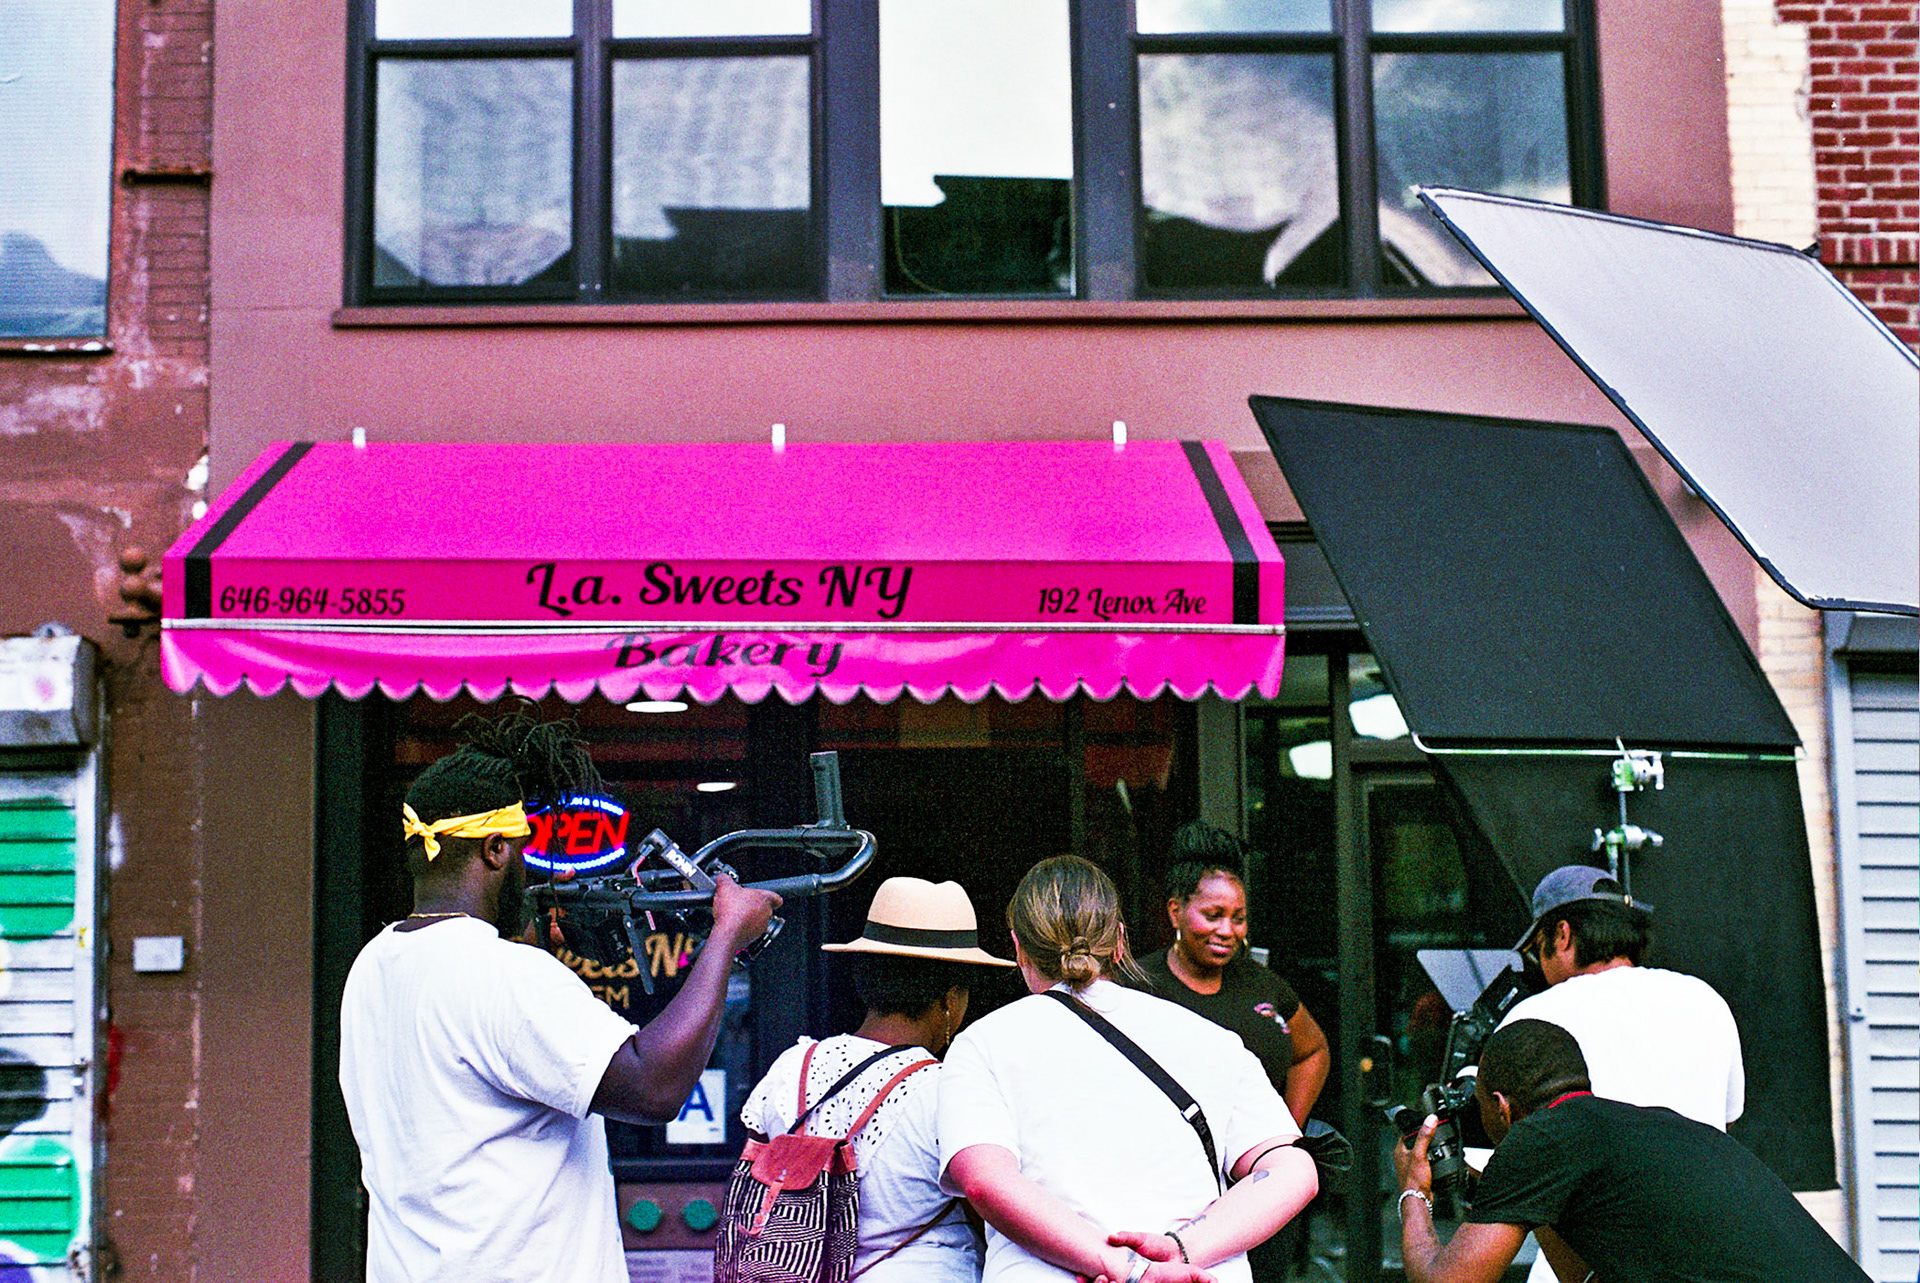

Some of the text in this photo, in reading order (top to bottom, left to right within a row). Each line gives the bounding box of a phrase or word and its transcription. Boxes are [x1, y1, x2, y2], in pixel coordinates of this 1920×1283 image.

[220, 586, 405, 615] 646-964-5855
[526, 562, 913, 619] L.a. Sweets NY
[1038, 587, 1207, 622] 192 Lenox Ave
[605, 634, 844, 677] Bakery
[523, 811, 630, 856] OPEN
[665, 848, 698, 878] RONIN
[678, 1081, 715, 1122] A
